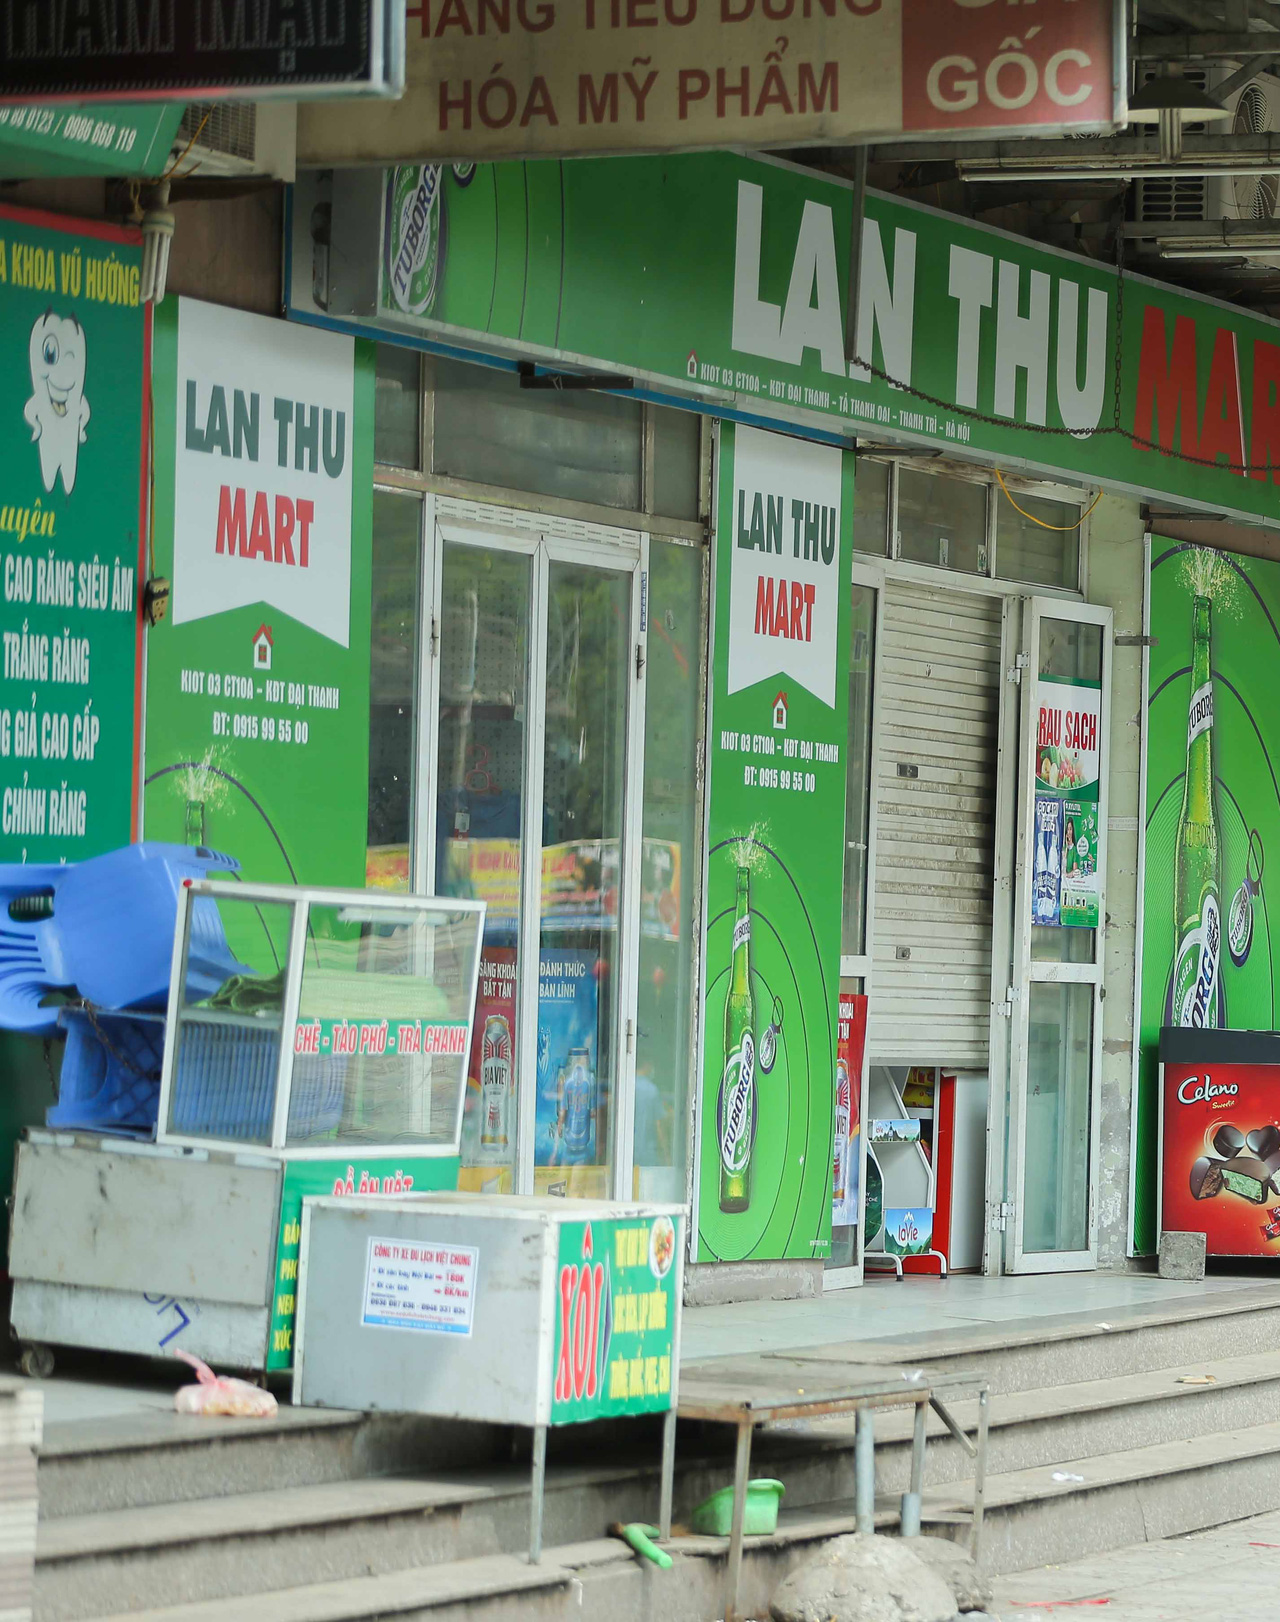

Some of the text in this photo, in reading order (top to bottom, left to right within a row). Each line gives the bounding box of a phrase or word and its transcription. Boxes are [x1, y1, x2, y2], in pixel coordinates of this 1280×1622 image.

[437, 36, 839, 131] HÓA MỸ PHẨM
[926, 25, 1093, 113] GỐC
[11, 244, 140, 307] KHOA VŨ HƯỜNG
[731, 179, 1108, 440] LAN THU
[186, 379, 346, 478] LAN THU
[215, 484, 315, 568] MART
[738, 489, 836, 565] LAN THU
[4, 549, 134, 611] CAO RĂNG SIÊU ÂM
[754, 575, 815, 642] MART
[3, 617, 90, 685] TRẮNG RĂNG
[14, 691, 100, 761] GIẢ CAO CẤP
[721, 731, 839, 763] KIOT 03 CT10A KĐT ĐẠI THANH
[1038, 706, 1097, 758] RAU SẠCH
[2, 770, 87, 836] CHỈNH RĂNG
[744, 765, 816, 792] ĐT: 0915 99 55 00
[498, 981, 512, 999] TẬN
[539, 981, 575, 998] BẢN LĨNH
[540, 960, 585, 978] ĐÁNH THỨC
[294, 1018, 467, 1054] CHÈ TÀO PHỚ TRÀ CHANH
[723, 1064, 750, 1160] TUBORG
[1177, 1074, 1239, 1105] Celano
[555, 1220, 604, 1402] XÔI
